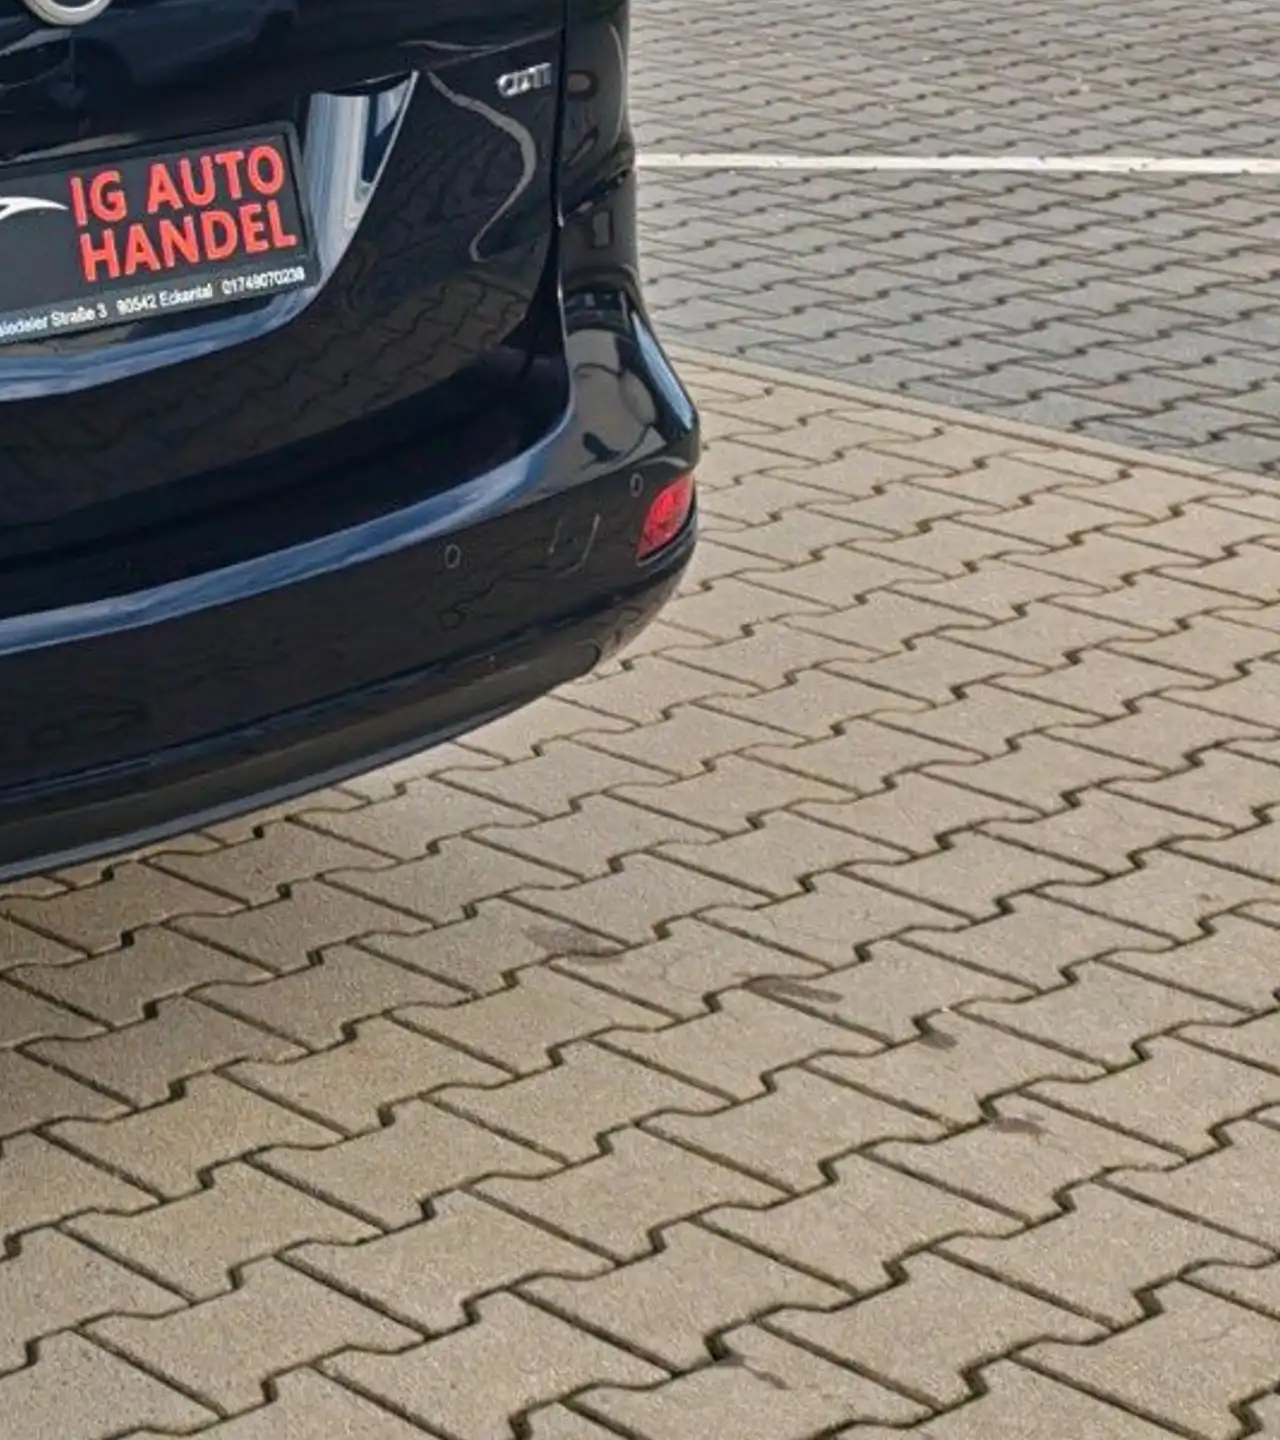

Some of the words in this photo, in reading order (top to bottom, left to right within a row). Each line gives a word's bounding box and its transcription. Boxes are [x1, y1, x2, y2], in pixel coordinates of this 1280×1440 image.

[70, 170, 128, 227] IG
[147, 144, 285, 215] AUTO
[79, 199, 299, 282] HANDEL
[51, 307, 96, 328] Straße
[96, 303, 108, 319] 3
[116, 295, 159, 315] 90542
[159, 283, 214, 308] Eckental
